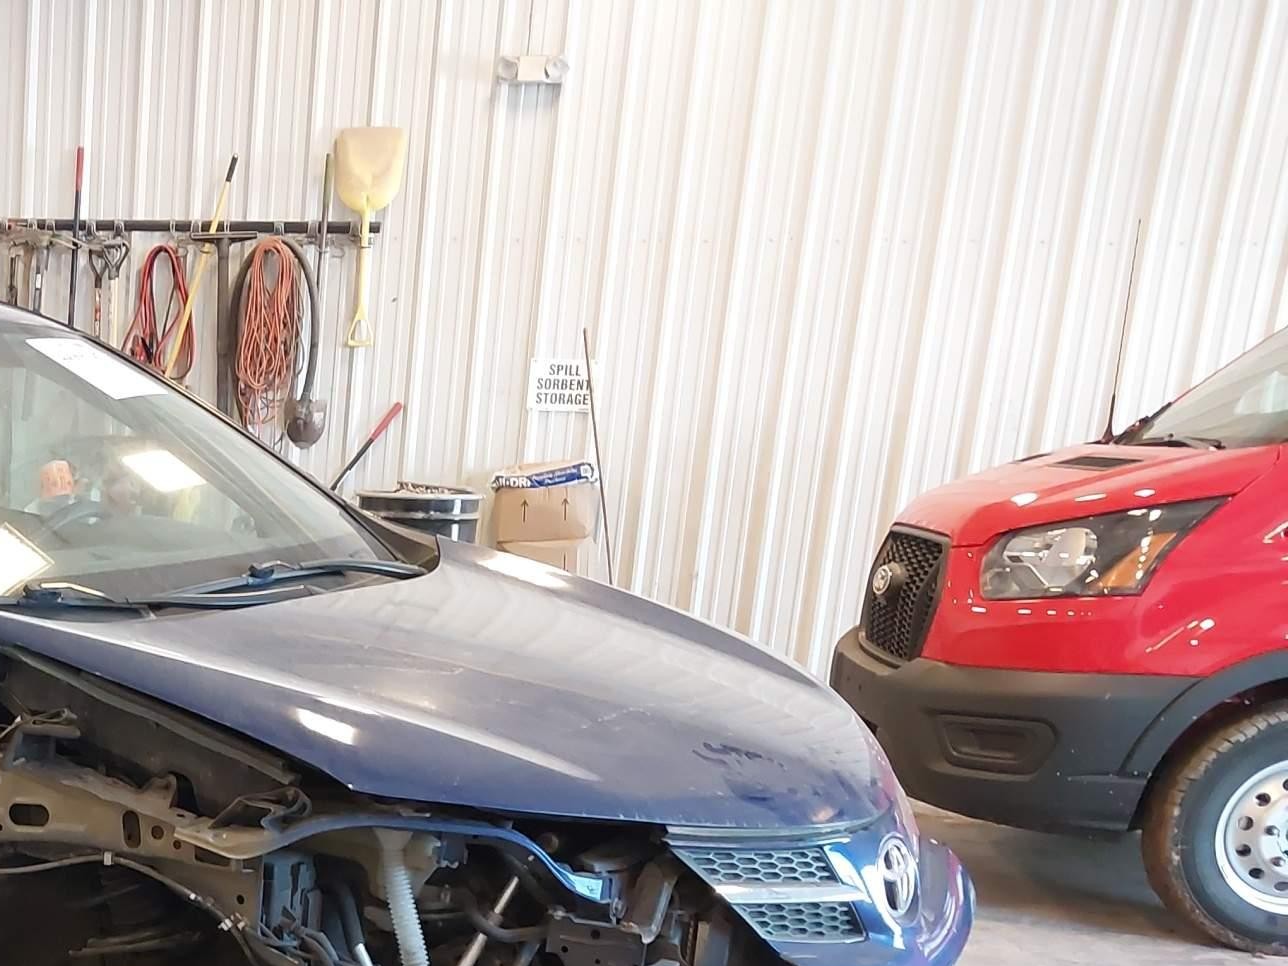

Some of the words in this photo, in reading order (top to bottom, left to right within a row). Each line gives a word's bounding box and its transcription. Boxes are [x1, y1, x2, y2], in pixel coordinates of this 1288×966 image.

[549, 364, 581, 376] SPILL
[536, 378, 590, 391] SORBENT
[535, 392, 589, 405] STORAGE
